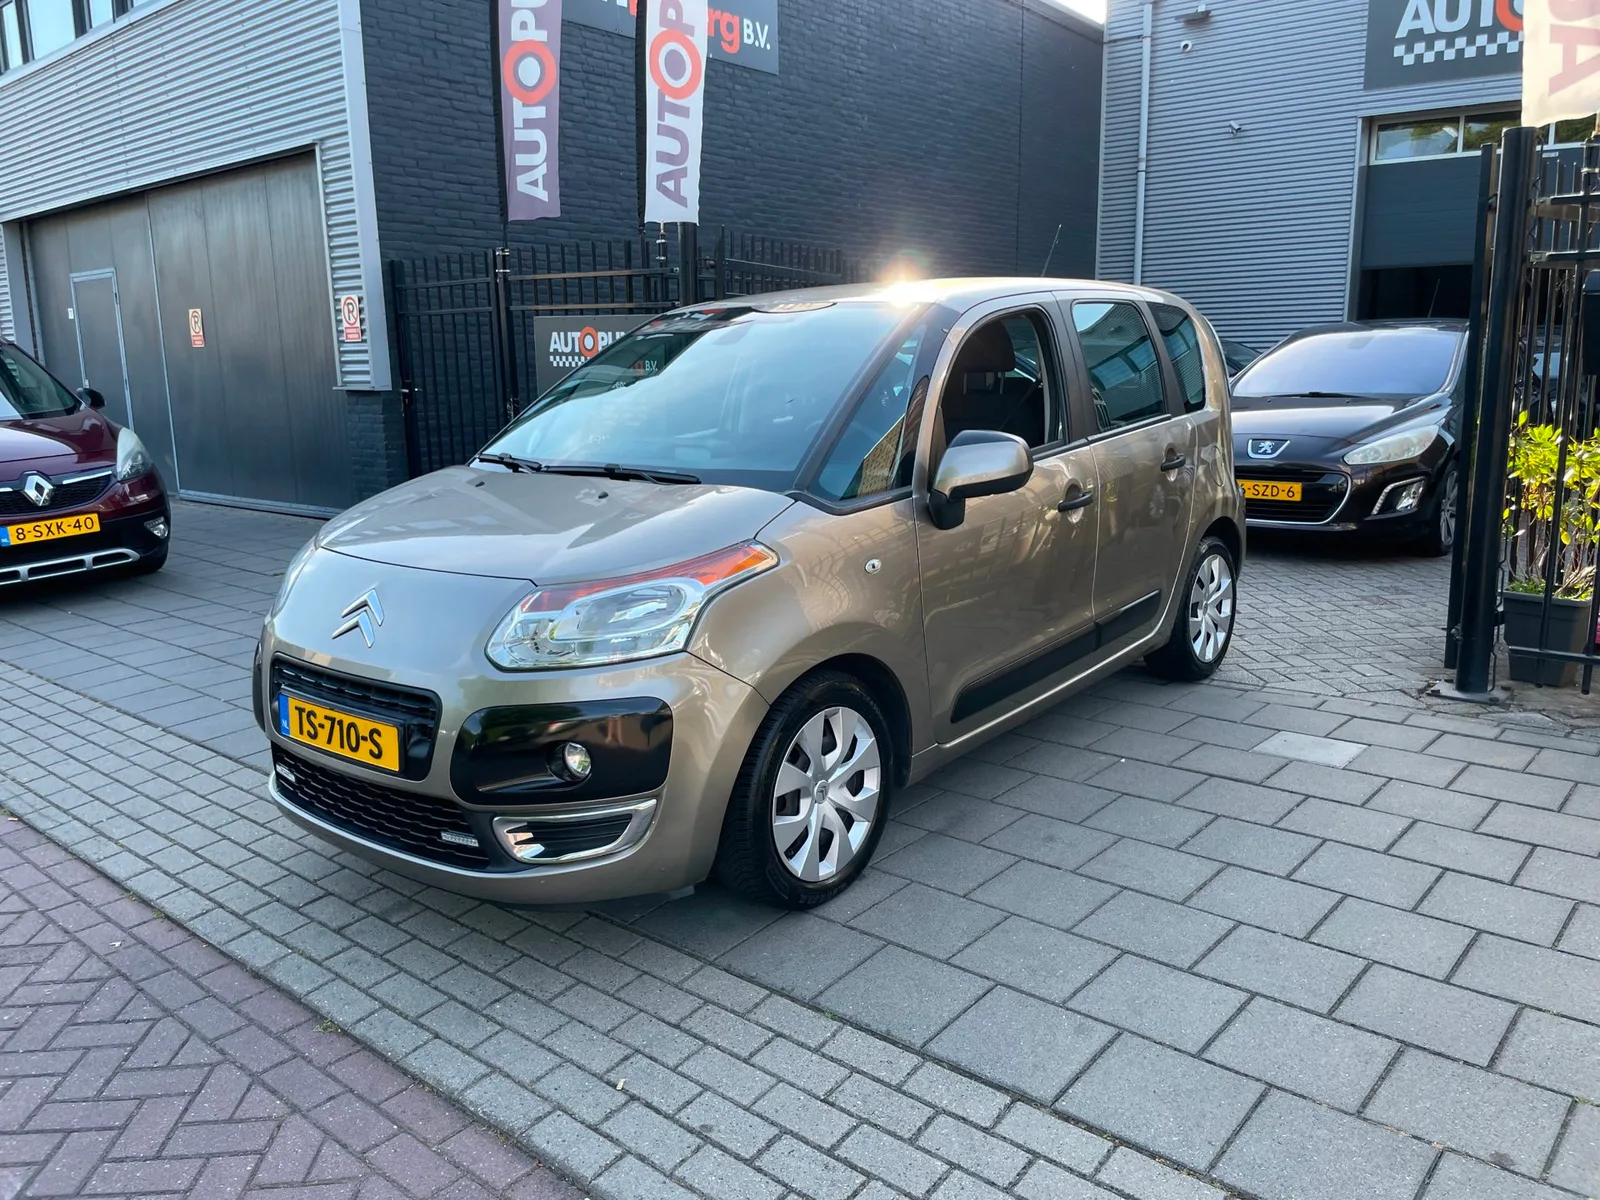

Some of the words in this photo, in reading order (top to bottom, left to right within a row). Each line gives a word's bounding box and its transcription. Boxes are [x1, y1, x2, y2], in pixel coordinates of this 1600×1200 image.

[743, 17, 771, 51] B.V.
[503, 0, 557, 203] AUTOP
[16, 517, 94, 541] 8-SXK-40
[295, 705, 383, 760] TS-710-S
